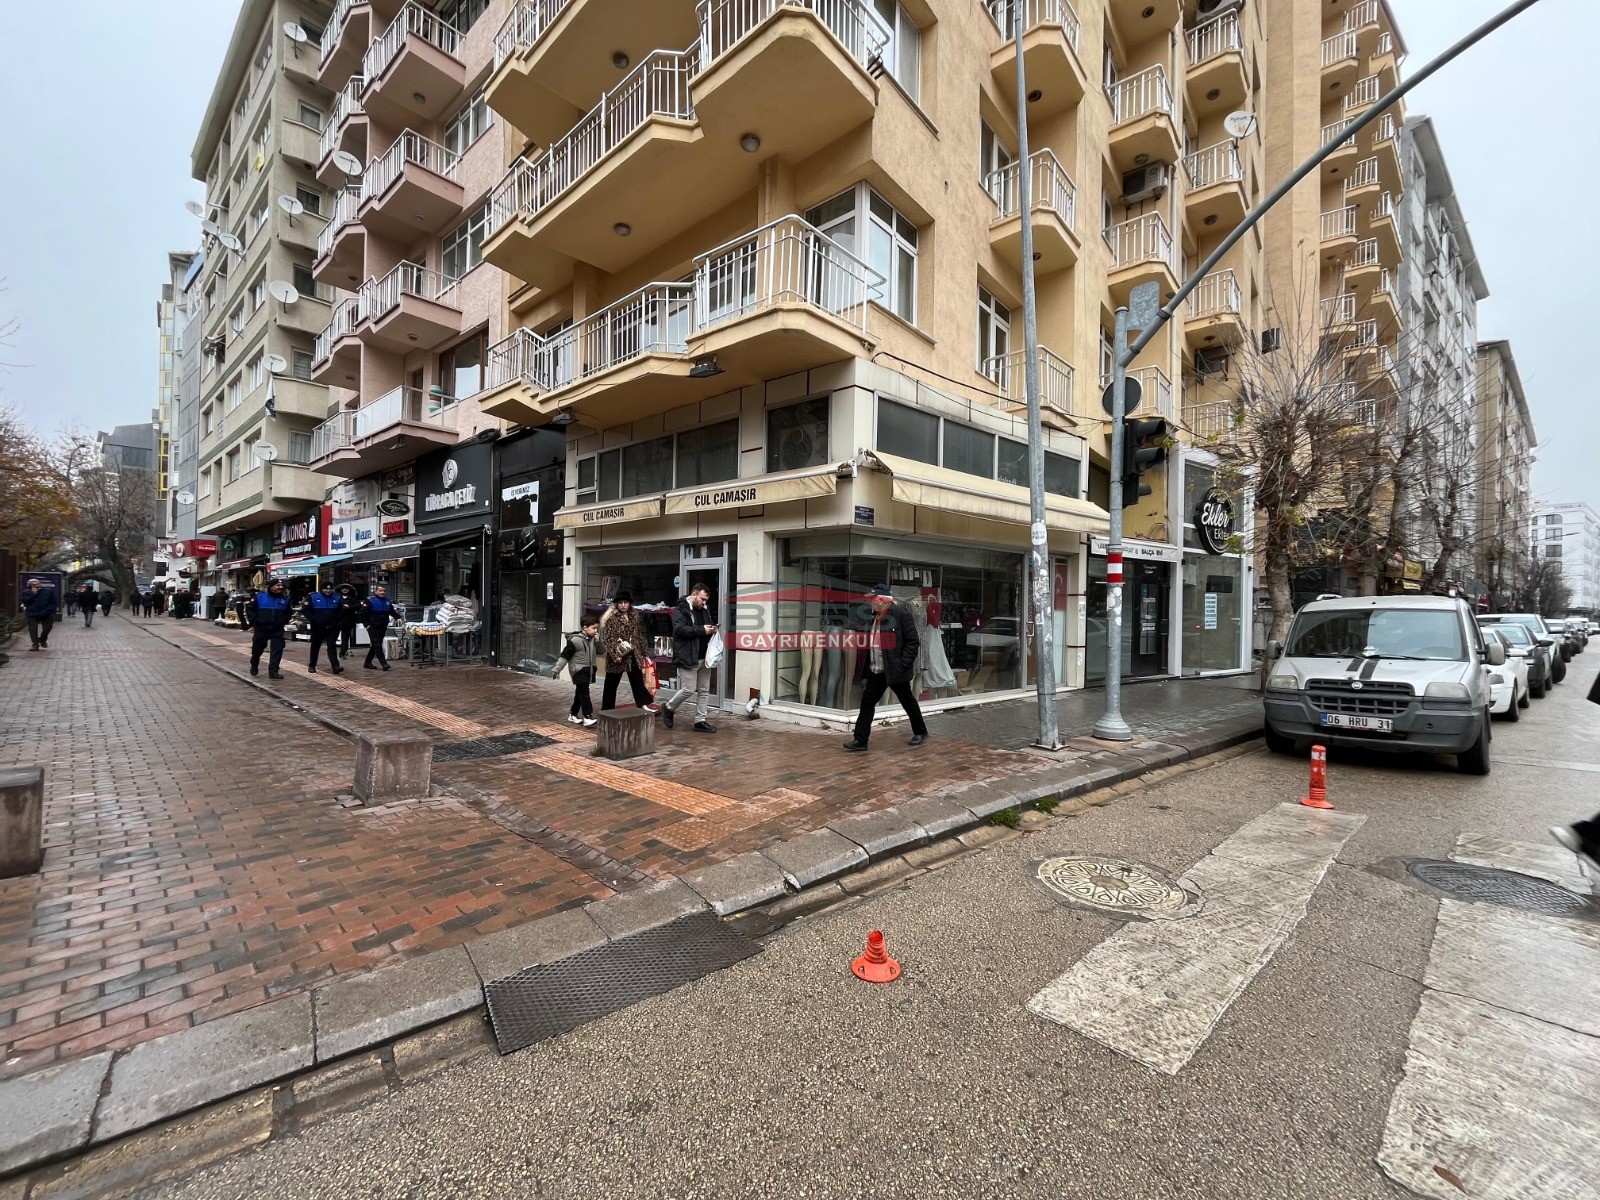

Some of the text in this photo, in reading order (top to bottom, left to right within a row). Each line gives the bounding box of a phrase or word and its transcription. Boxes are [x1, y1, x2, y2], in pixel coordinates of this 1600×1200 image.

[694, 488, 757, 508] ÇUL ÇAMAŞIR
[595, 507, 625, 521] ÇAMAŞIR
[1201, 502, 1229, 527] Ekler
[360, 529, 372, 540] aura
[1327, 715, 1340, 724] 06
[1348, 716, 1368, 727] HRU
[1377, 719, 1390, 729] 31
